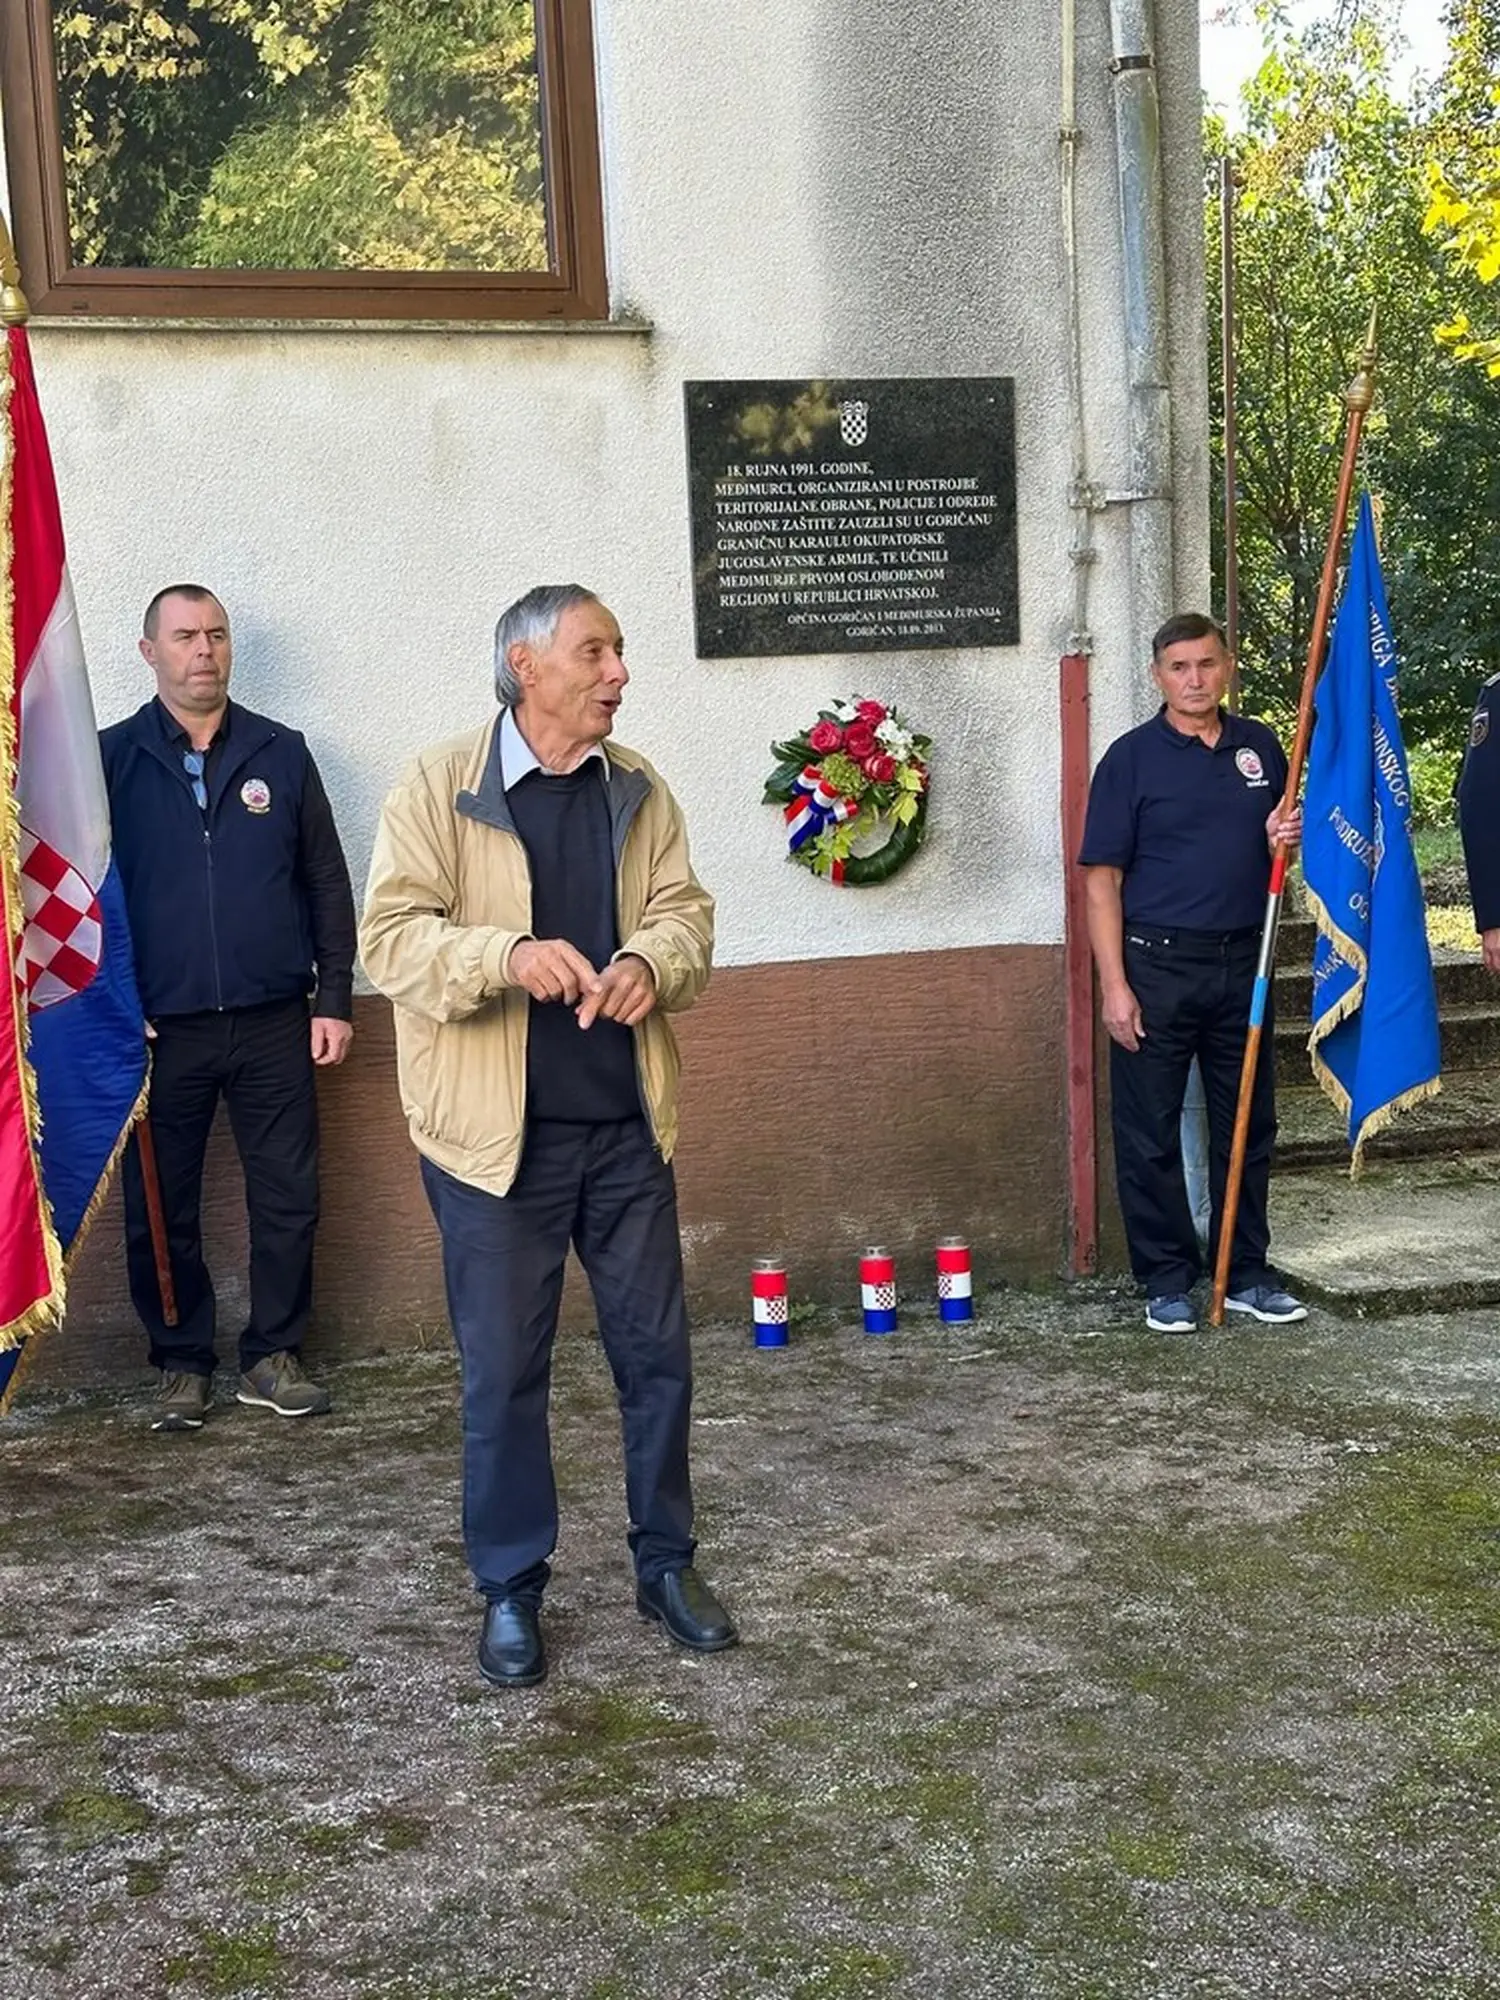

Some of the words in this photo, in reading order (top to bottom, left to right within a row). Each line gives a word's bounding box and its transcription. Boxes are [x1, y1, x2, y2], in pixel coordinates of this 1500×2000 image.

[745, 463, 788, 477] RUJNA
[790, 463, 819, 476] 1991.
[820, 461, 875, 475] GODINE,
[798, 479, 892, 494] ORGANIZIRANI
[895, 479, 905, 491] U
[907, 477, 979, 492] POSTROJBE
[715, 500, 819, 514] TERITORIJALNE
[821, 498, 877, 512] OBRANE,
[879, 497, 937, 510] POLICIJE
[938, 497, 944, 508] I
[945, 495, 997, 509] ODREDE
[716, 518, 780, 533] NARODNE
[782, 516, 836, 531] ZAŠTITE
[838, 515, 893, 529] ZAUZELI
[895, 515, 911, 528] SU
[914, 514, 924, 527] U
[925, 511, 993, 526] GORIČANU
[717, 535, 787, 551] GRANIČNU
[789, 535, 851, 549] KARAULU
[853, 532, 945, 547] OKUPATORSKE
[717, 554, 825, 569] JUGOSLAVENSKE
[827, 552, 880, 566] ARMIJE,
[881, 552, 898, 564] TE
[900, 548, 949, 563] UČINILI
[800, 571, 845, 586] PRVOM
[720, 592, 779, 607] REGIJOM
[781, 592, 792, 604] U
[793, 589, 861, 604] REPUBLICI
[864, 587, 940, 601] HRVATSKOJ.
